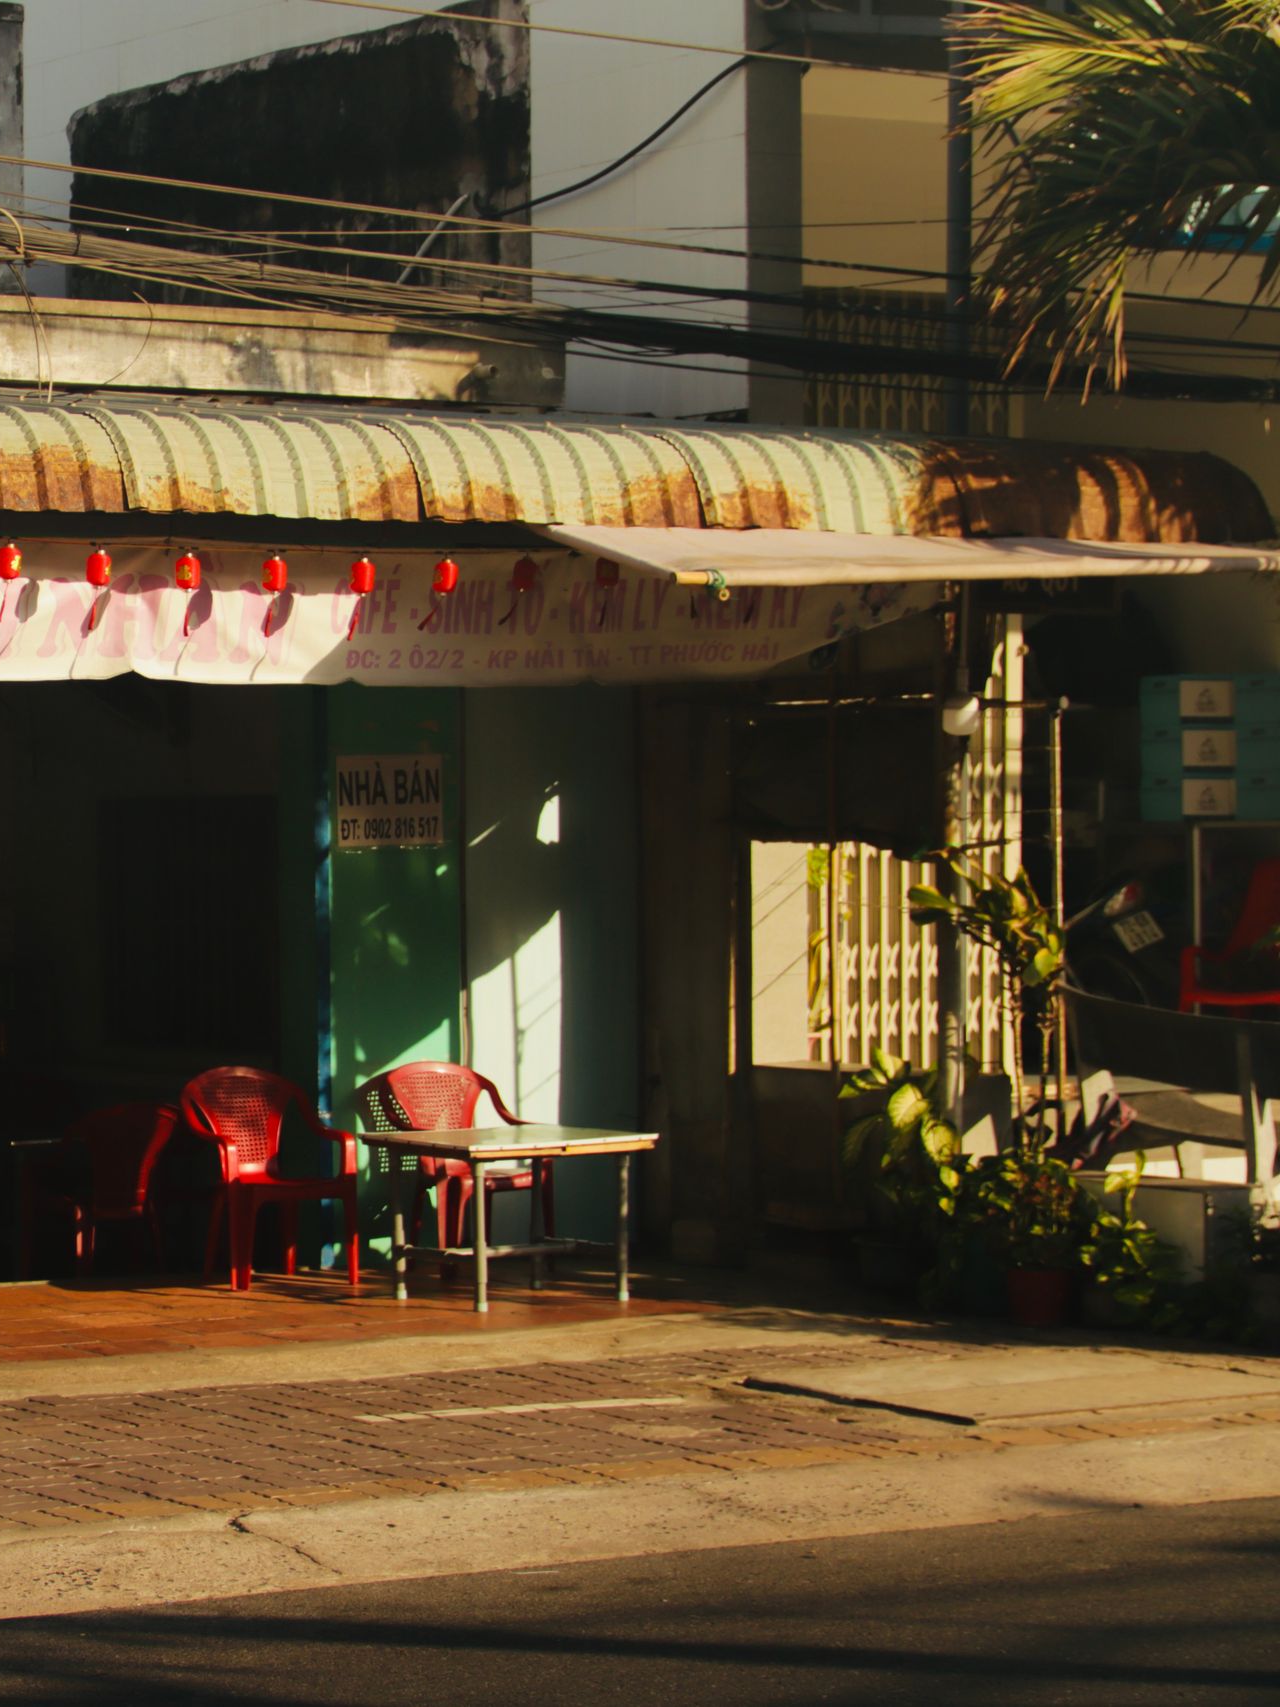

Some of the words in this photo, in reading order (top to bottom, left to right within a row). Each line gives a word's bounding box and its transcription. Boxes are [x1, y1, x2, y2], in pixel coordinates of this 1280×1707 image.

[429, 580, 495, 634] SINH
[569, 578, 628, 633] KEM
[346, 649, 380, 669] ĐC:
[388, 649, 401, 669] 2
[409, 643, 465, 669] Ô2/2
[488, 650, 517, 669] KP
[525, 641, 563, 669] HẢI
[629, 645, 656, 665] TT
[660, 639, 735, 664] PHƯỚC
[741, 636, 780, 661] HẢI
[339, 761, 388, 806] NHÀ
[394, 760, 439, 805] BÁN
[341, 819, 360, 840] ĐT:
[364, 818, 391, 839] 0902
[395, 817, 415, 838] 816
[418, 816, 439, 837] 517
